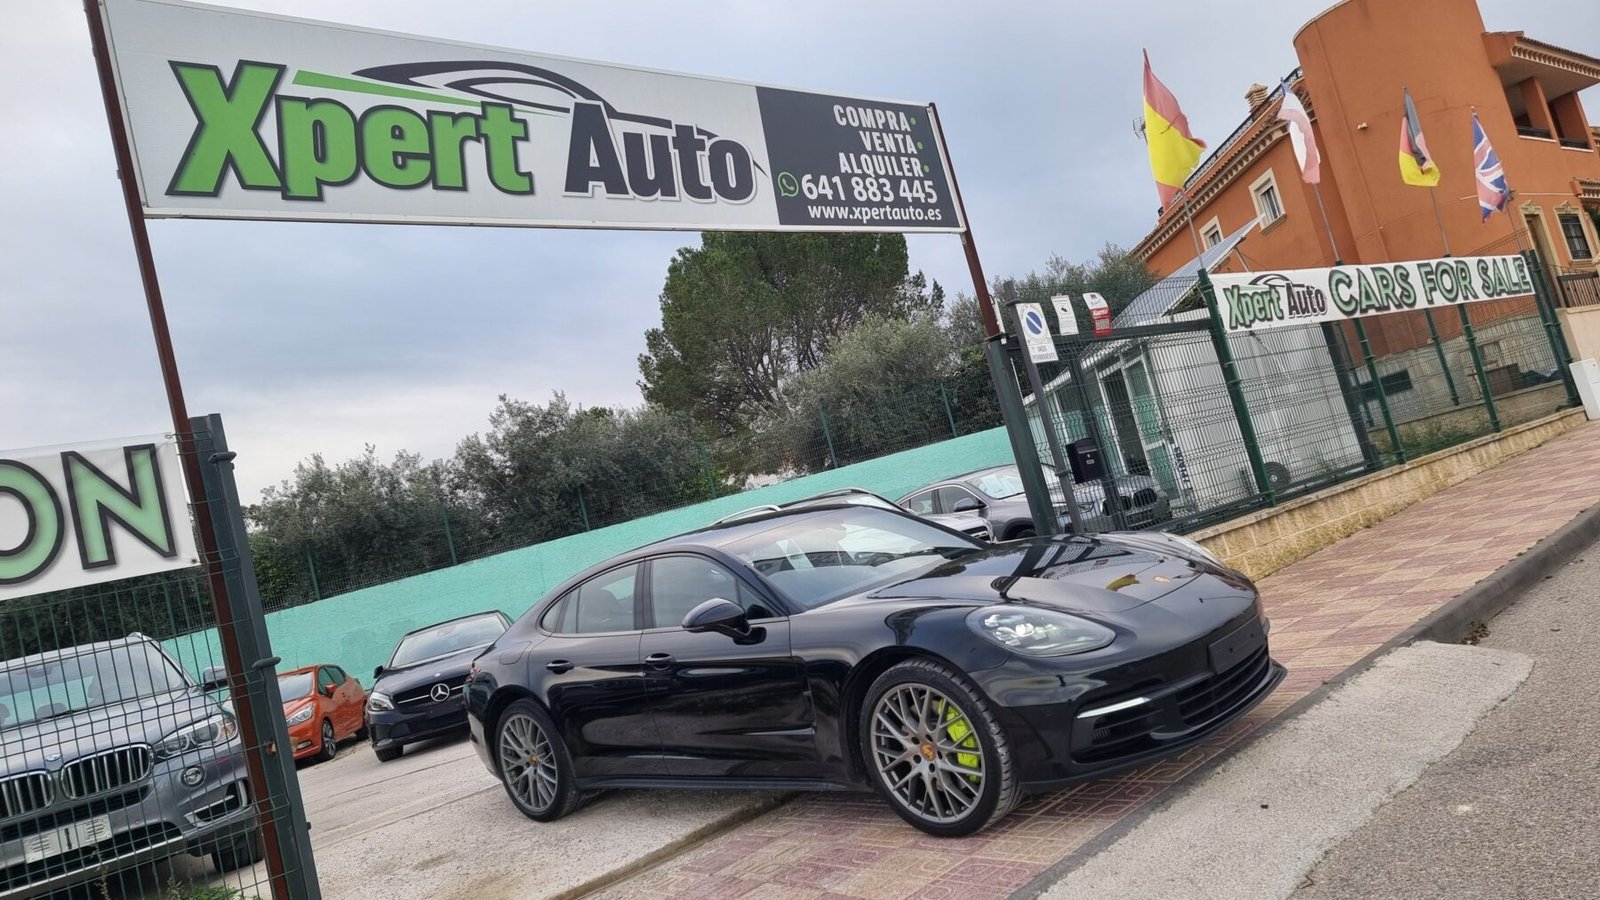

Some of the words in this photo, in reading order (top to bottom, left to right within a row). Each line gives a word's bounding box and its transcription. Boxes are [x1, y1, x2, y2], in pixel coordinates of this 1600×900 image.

[165, 59, 534, 201] Xpert
[564, 100, 758, 204] Auto
[832, 104, 912, 132] COMPRA
[859, 130, 918, 155] VENTA
[838, 152, 924, 178] ALQUILER
[801, 174, 846, 201] 641
[851, 177, 895, 202] 883
[899, 179, 938, 204] 445
[807, 205, 942, 223] www.xpertauto.es
[1222, 284, 1284, 330] Xpert
[1285, 281, 1327, 318] Auto
[1328, 265, 1417, 317] CARS
[1416, 260, 1480, 304] FOR
[1476, 256, 1532, 298] SALE
